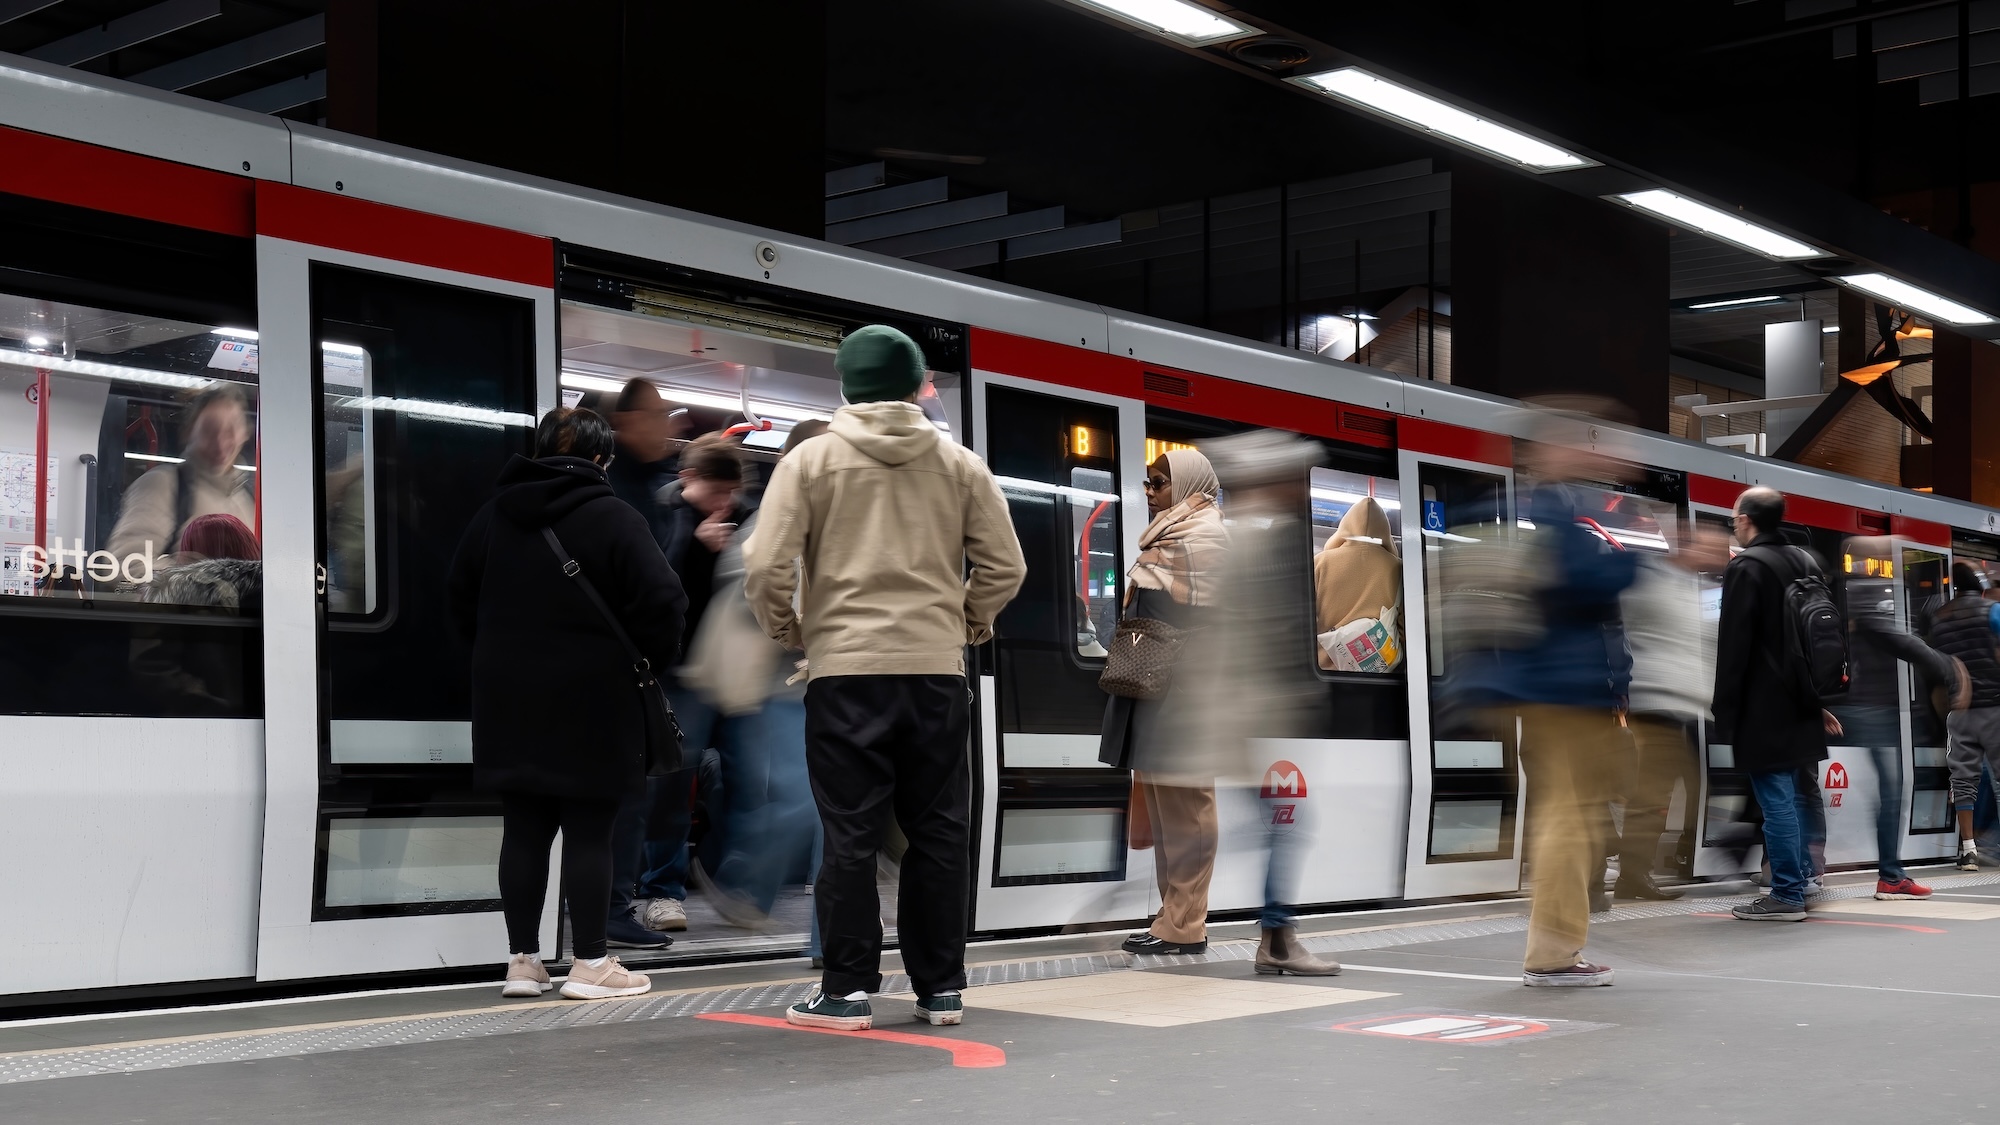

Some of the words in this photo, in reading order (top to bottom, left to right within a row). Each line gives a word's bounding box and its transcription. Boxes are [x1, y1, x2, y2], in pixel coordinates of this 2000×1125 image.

[1077, 426, 1089, 456] B
[1844, 554, 1852, 573] B
[1270, 770, 1298, 794] M
[1830, 769, 1845, 787] M
